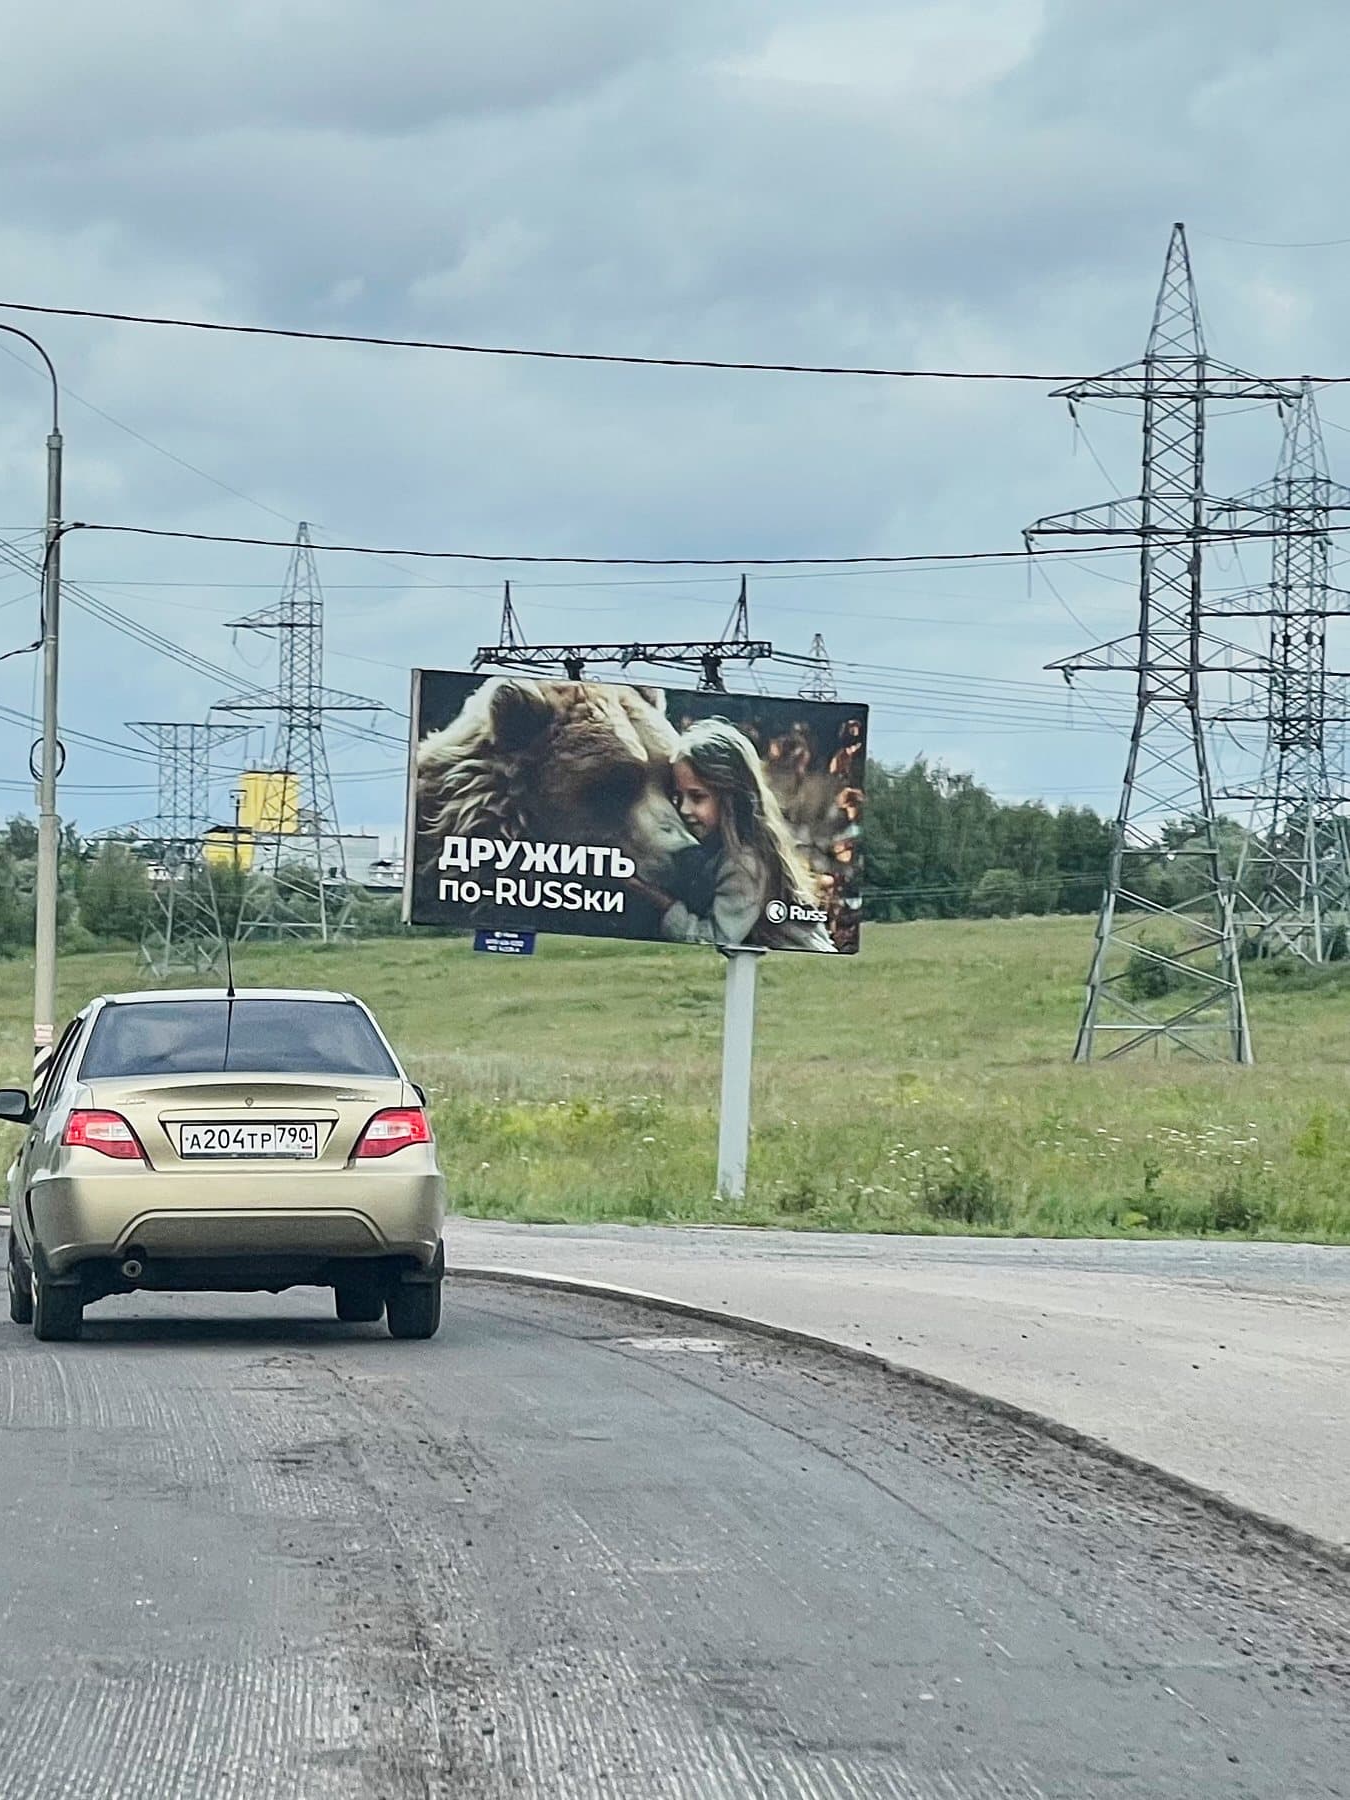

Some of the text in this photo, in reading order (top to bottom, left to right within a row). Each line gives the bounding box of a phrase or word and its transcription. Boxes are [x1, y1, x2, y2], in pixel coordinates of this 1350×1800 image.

[438, 835, 636, 878] ДРУЖИТЬ
[439, 877, 625, 913] по-RUSSки
[190, 1127, 309, 1150] А204ТР 790
